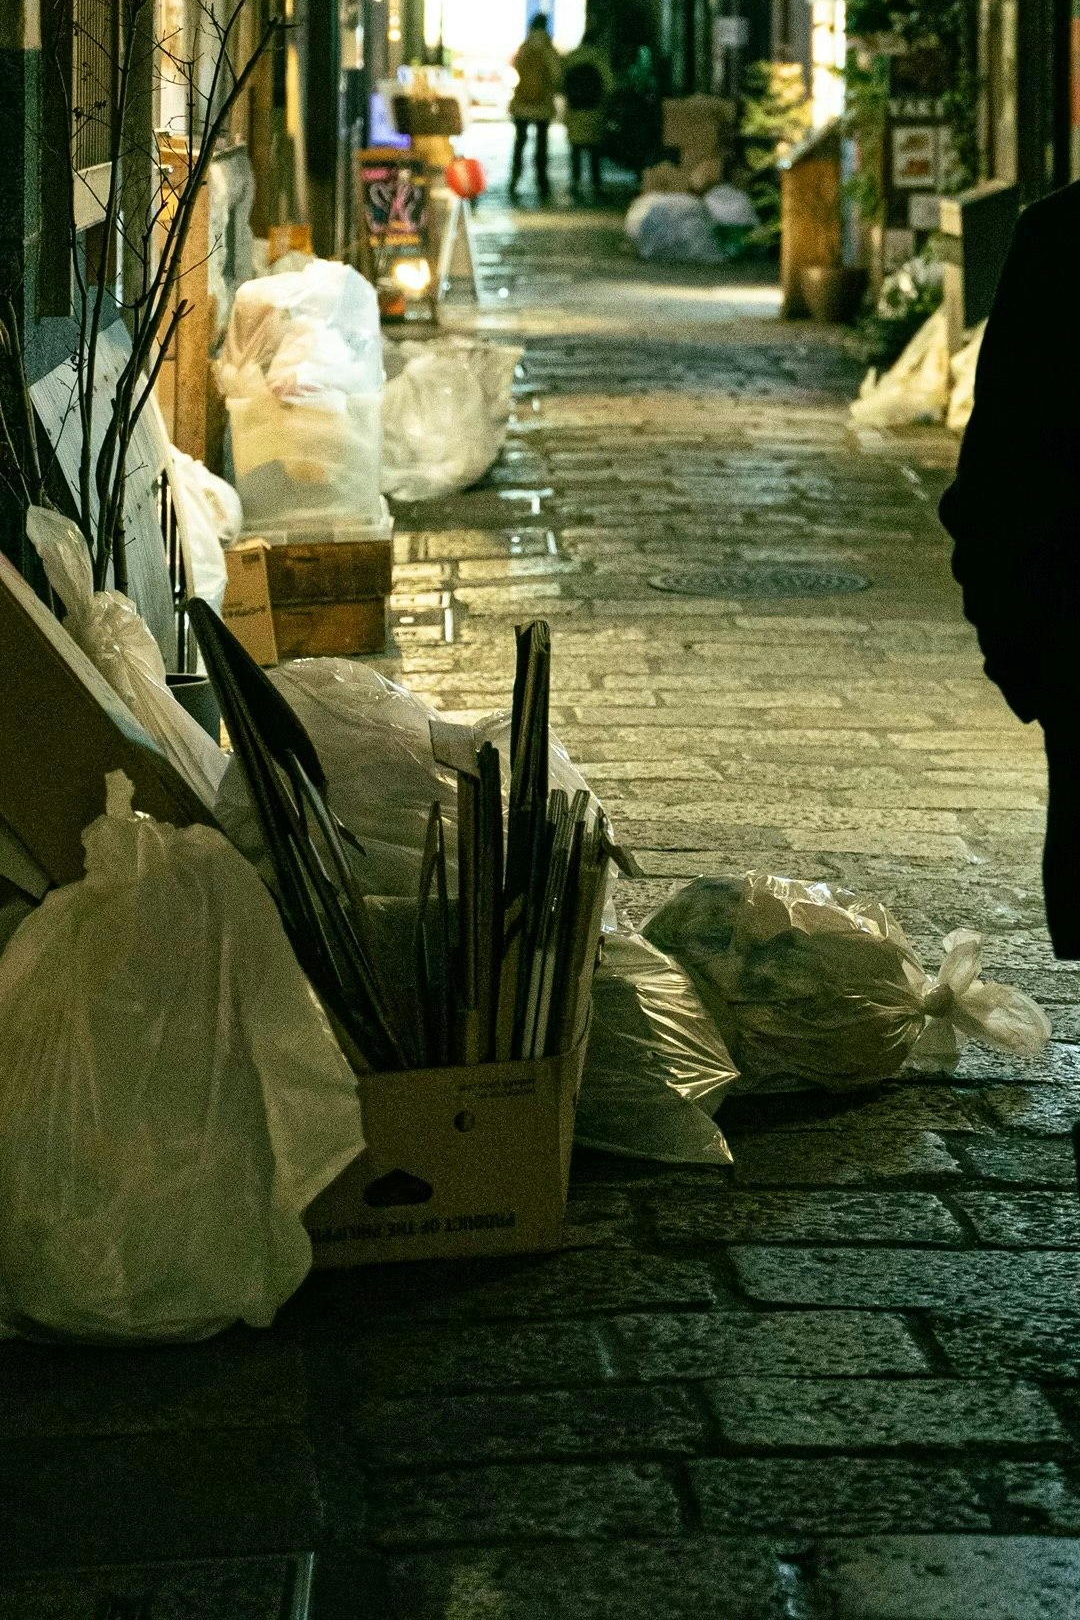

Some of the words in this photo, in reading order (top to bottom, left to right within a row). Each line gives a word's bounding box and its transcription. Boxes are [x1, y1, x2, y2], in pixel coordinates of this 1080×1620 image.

[386, 1221, 416, 1238] THE
[421, 1219, 440, 1235] OF
[446, 1212, 516, 1233] PRODUCT
